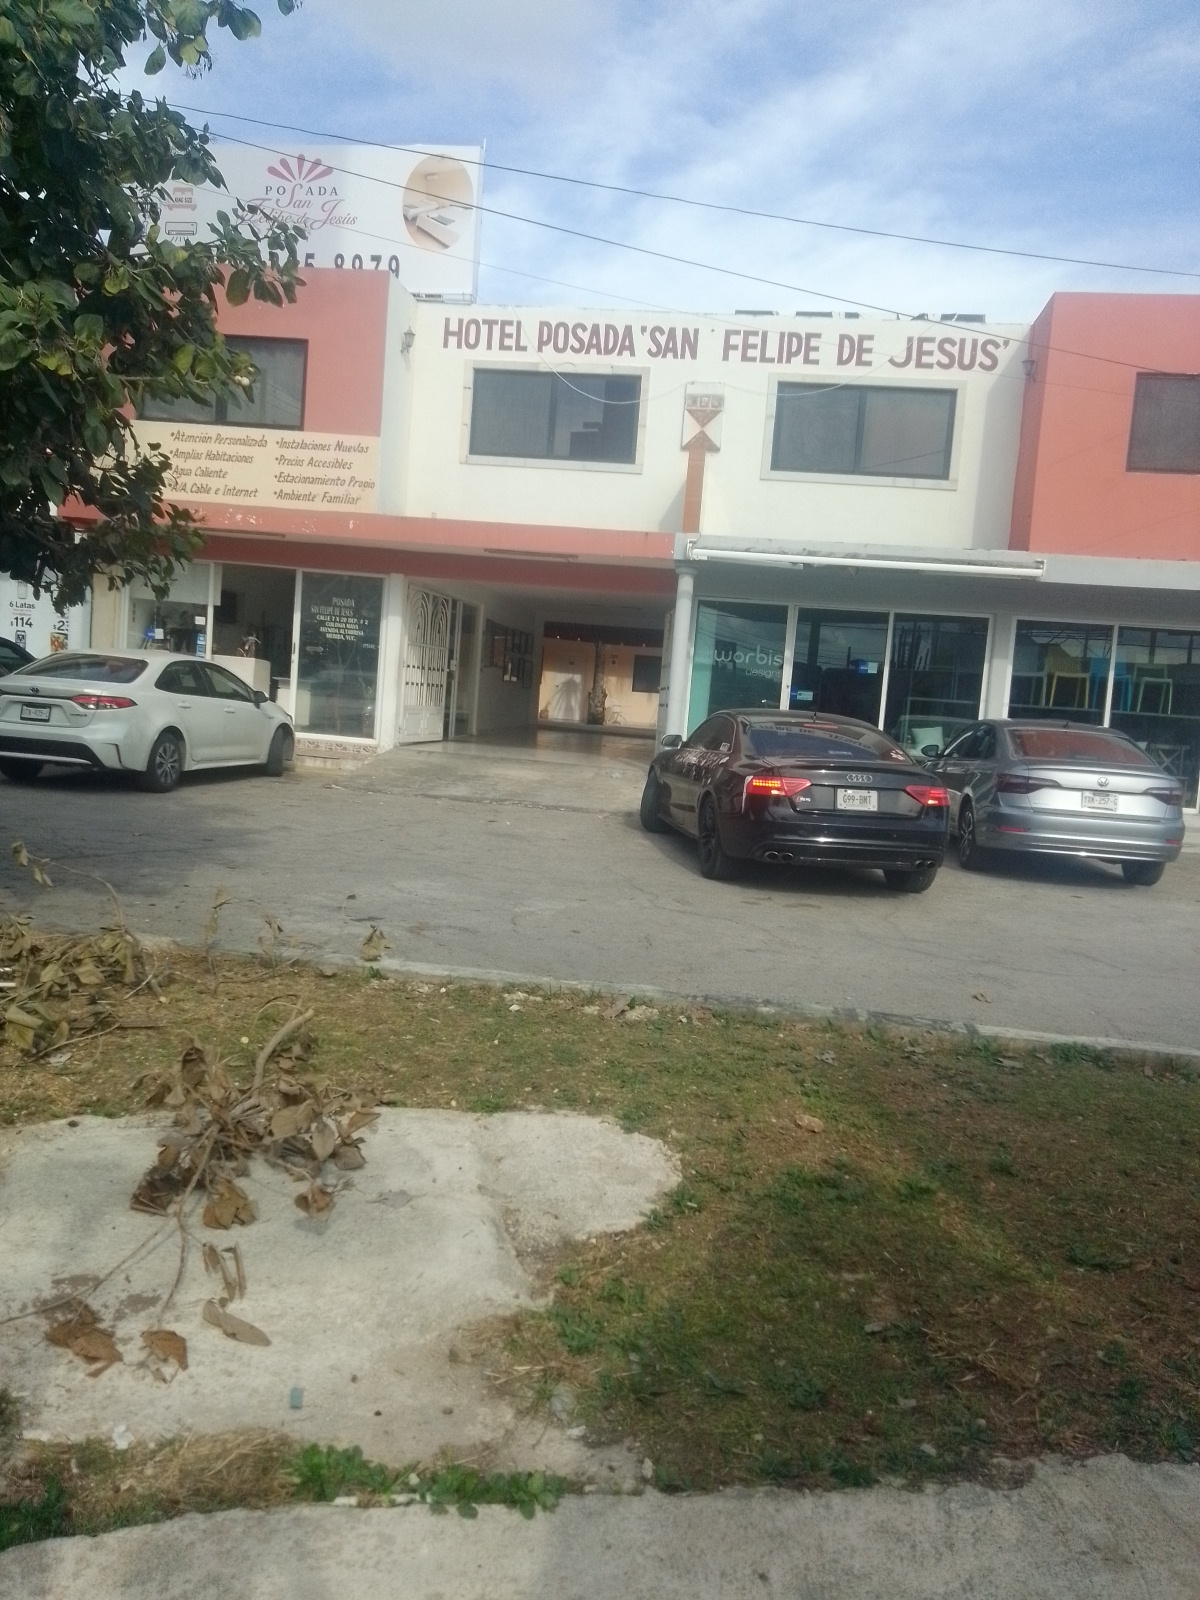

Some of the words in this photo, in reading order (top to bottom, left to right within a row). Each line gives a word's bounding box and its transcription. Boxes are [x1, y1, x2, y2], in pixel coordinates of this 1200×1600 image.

[265, 184, 338, 199] POSADA
[310, 199, 358, 230] Jesús
[442, 317, 528, 353] HOTEL
[537, 320, 636, 358] POSADA
[722, 329, 823, 366] FELIPE
[837, 334, 875, 367] DE
[174, 430, 212, 444] Atención
[214, 433, 268, 449] Personalizada
[278, 438, 331, 452] Instalaciones
[172, 448, 203, 463] Amplias
[204, 450, 254, 464] Habitaciones
[278, 455, 304, 468] Precios
[308, 458, 354, 470] Accesibles
[172, 465, 193, 480] Agua
[194, 466, 229, 480] Caliente
[278, 472, 346, 488] Estacionamiento
[348, 476, 376, 490] Propio
[190, 483, 212, 496] Cable
[214, 488, 221, 496] e
[222, 486, 259, 498] Internet
[276, 489, 317, 503] Ambiente
[321, 492, 361, 506] Familiar
[16, 601, 36, 609] Latas
[10, 616, 33, 628] $114
[714, 644, 783, 666] worbis
[842, 794, 872, 805] G99-BMT
